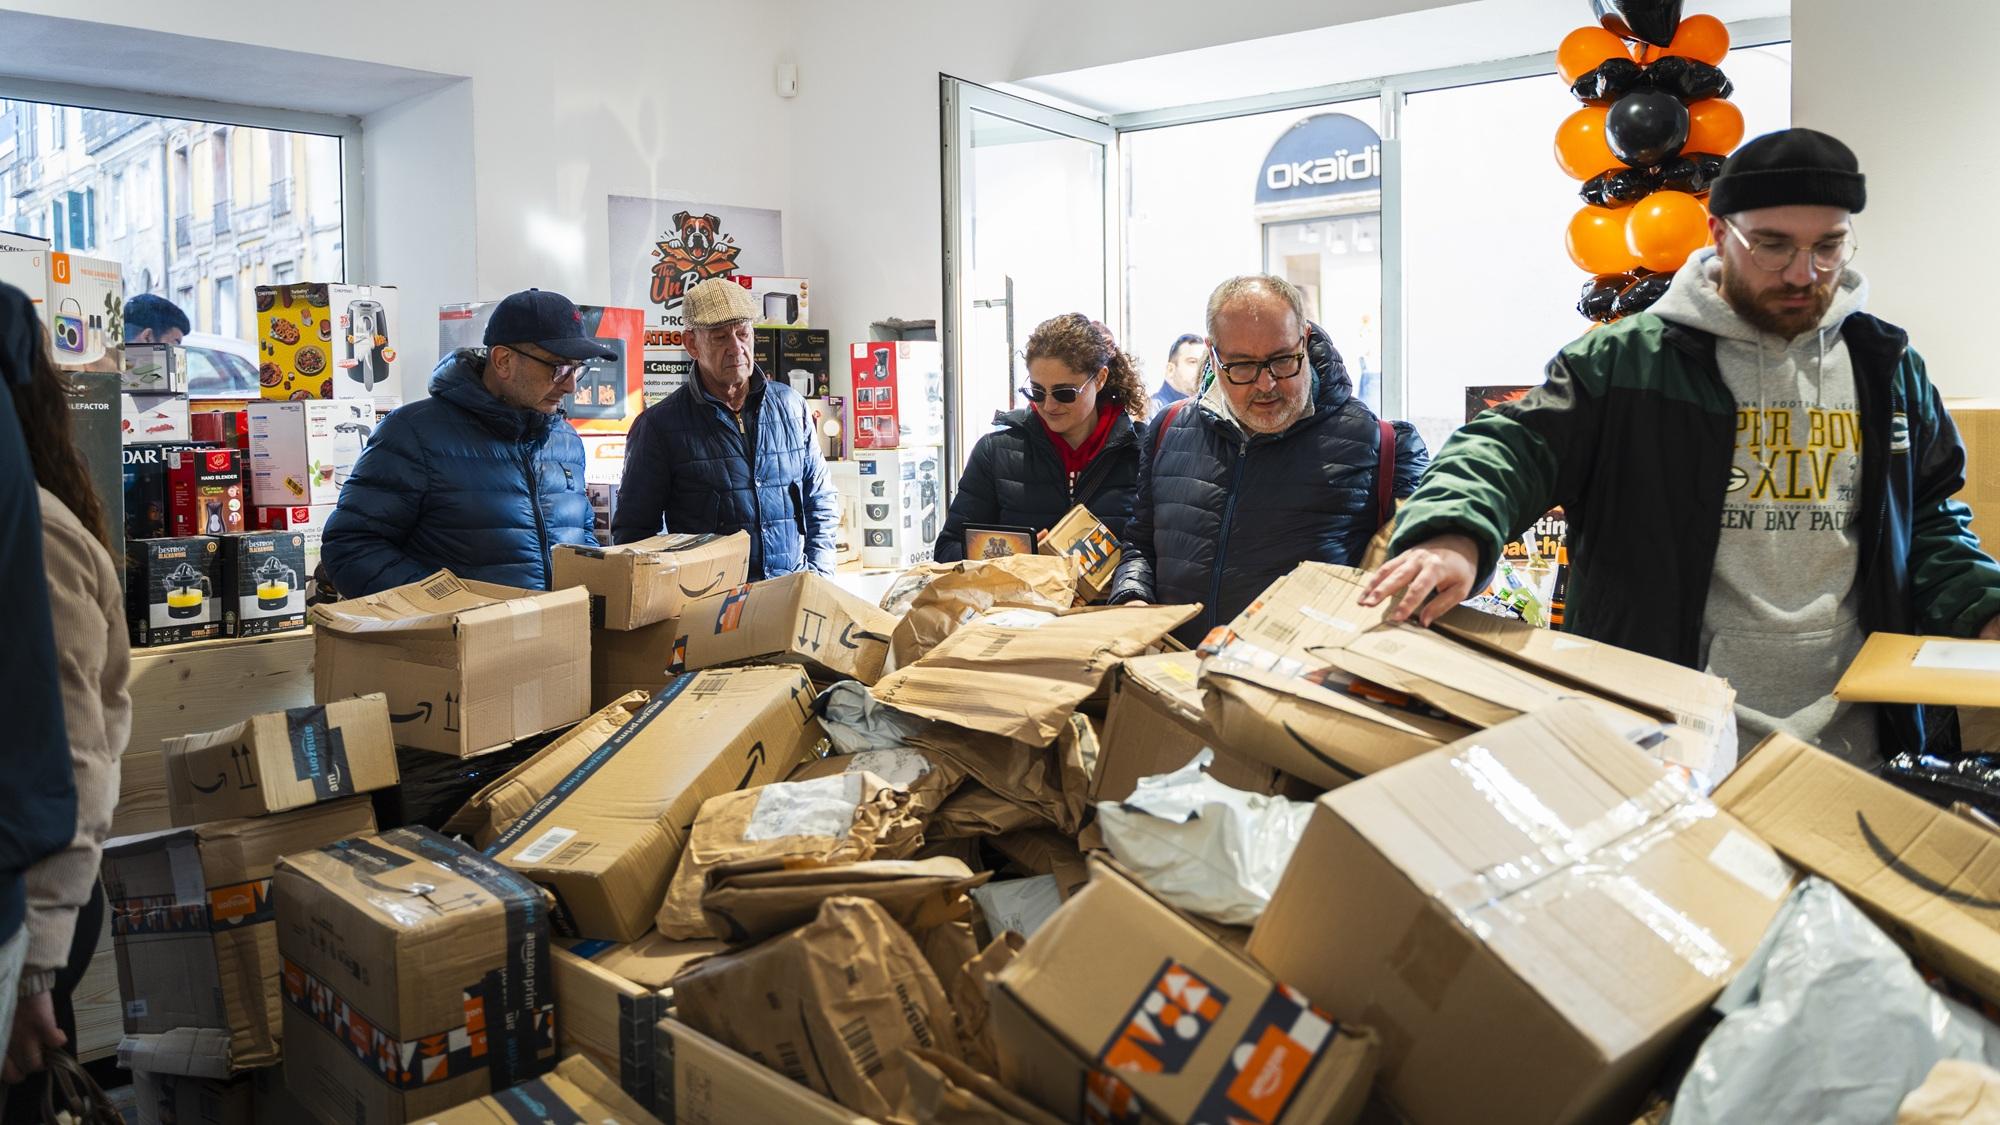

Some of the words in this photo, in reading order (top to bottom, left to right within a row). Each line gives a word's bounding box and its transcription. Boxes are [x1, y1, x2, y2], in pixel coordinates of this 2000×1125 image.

[1267, 145, 1380, 190] okaïdi
[644, 331, 683, 346] ATEG
[651, 363, 692, 373] Categori
[1736, 410, 1791, 447] PER
[1808, 410, 1861, 453] BOW
[122, 449, 159, 464] DAR
[1750, 449, 1837, 500] XLV
[1529, 516, 1568, 535] tin
[1721, 509, 1755, 530] EEN
[1764, 510, 1800, 530] BAY
[636, 699, 663, 724] amazon
[614, 722, 639, 743] prime
[559, 768, 586, 792] prime
[526, 795, 557, 820] amazon
[499, 819, 529, 844] prime
[523, 978, 538, 1010] prim
[896, 983, 932, 1049] amazon
